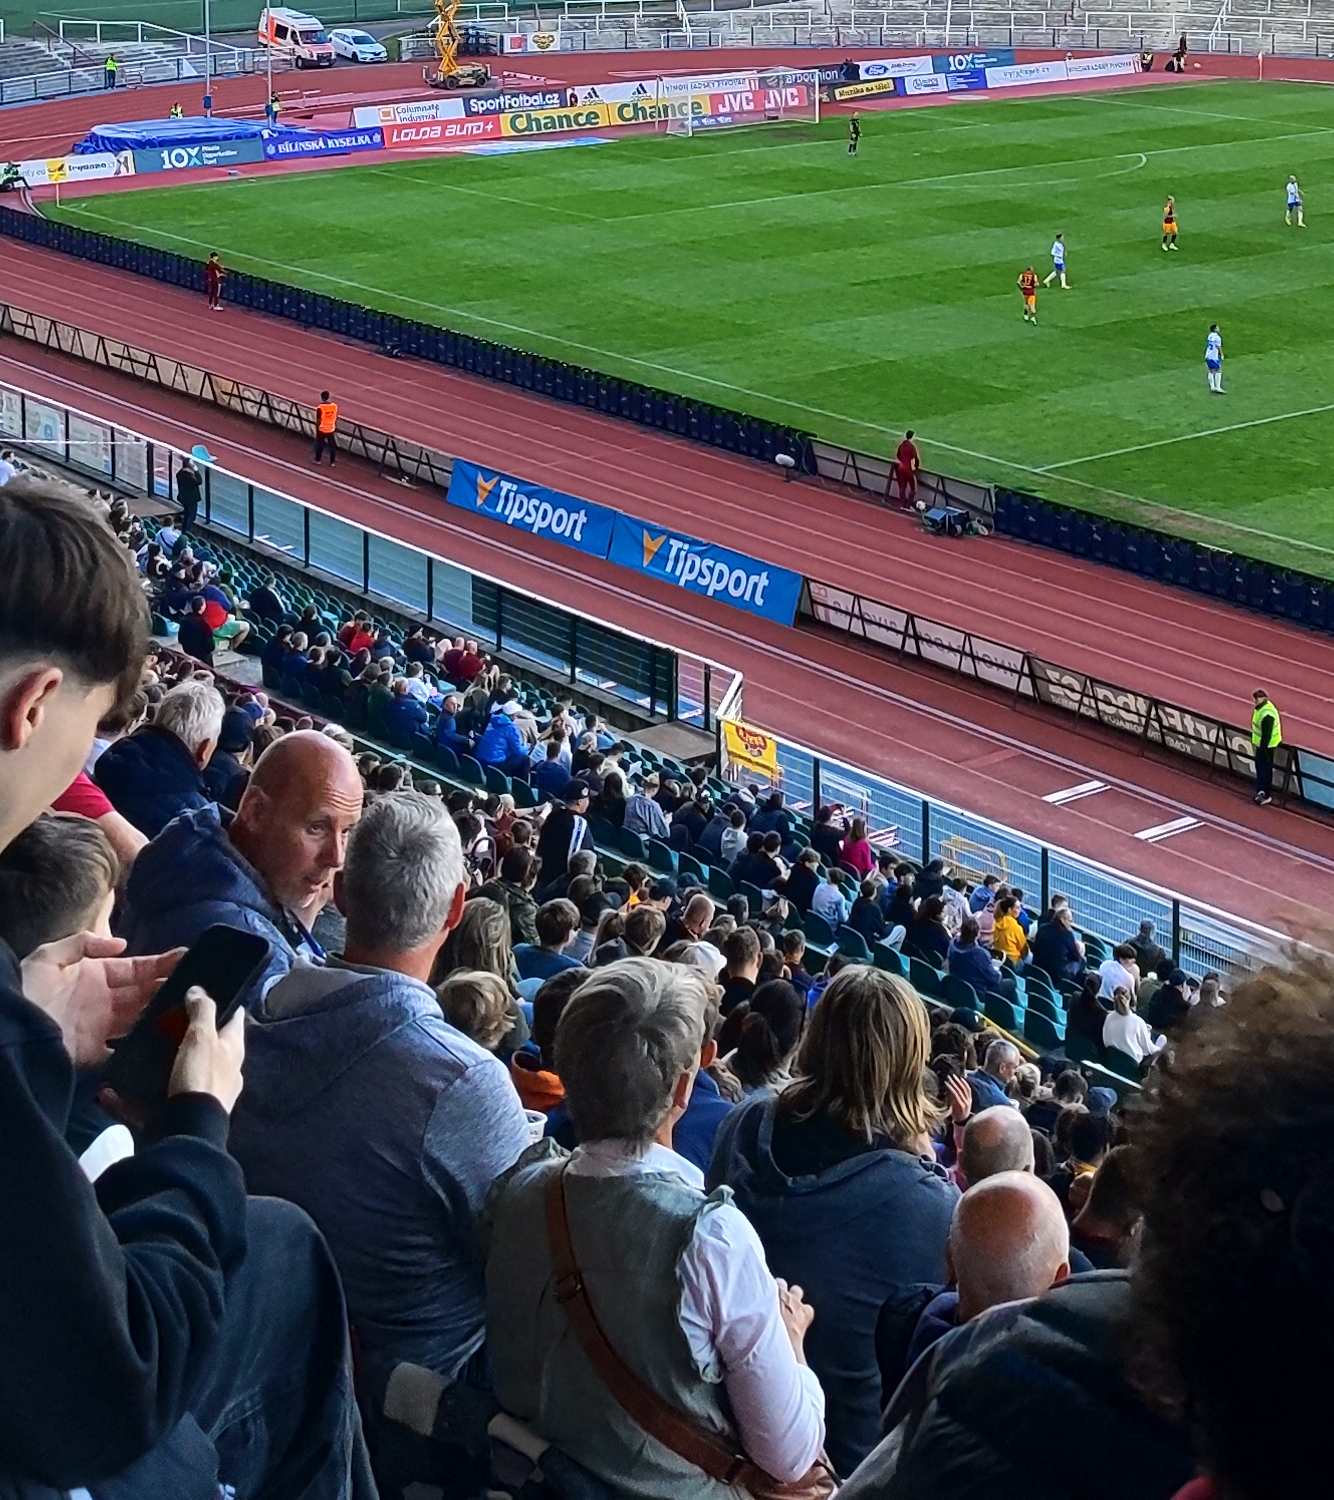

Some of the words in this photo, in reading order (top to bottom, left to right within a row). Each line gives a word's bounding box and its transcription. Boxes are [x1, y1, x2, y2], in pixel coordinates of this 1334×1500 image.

[470, 91, 560, 114] SportFotbal.cz
[718, 92, 754, 112] JVC
[764, 87, 799, 108] JVC
[509, 109, 600, 134] Chance
[617, 98, 703, 122] Chance
[327, 134, 371, 149] KYSELKA
[161, 146, 202, 169] 10X
[497, 480, 587, 541] Tipsport
[664, 538, 769, 606] Tipsport
